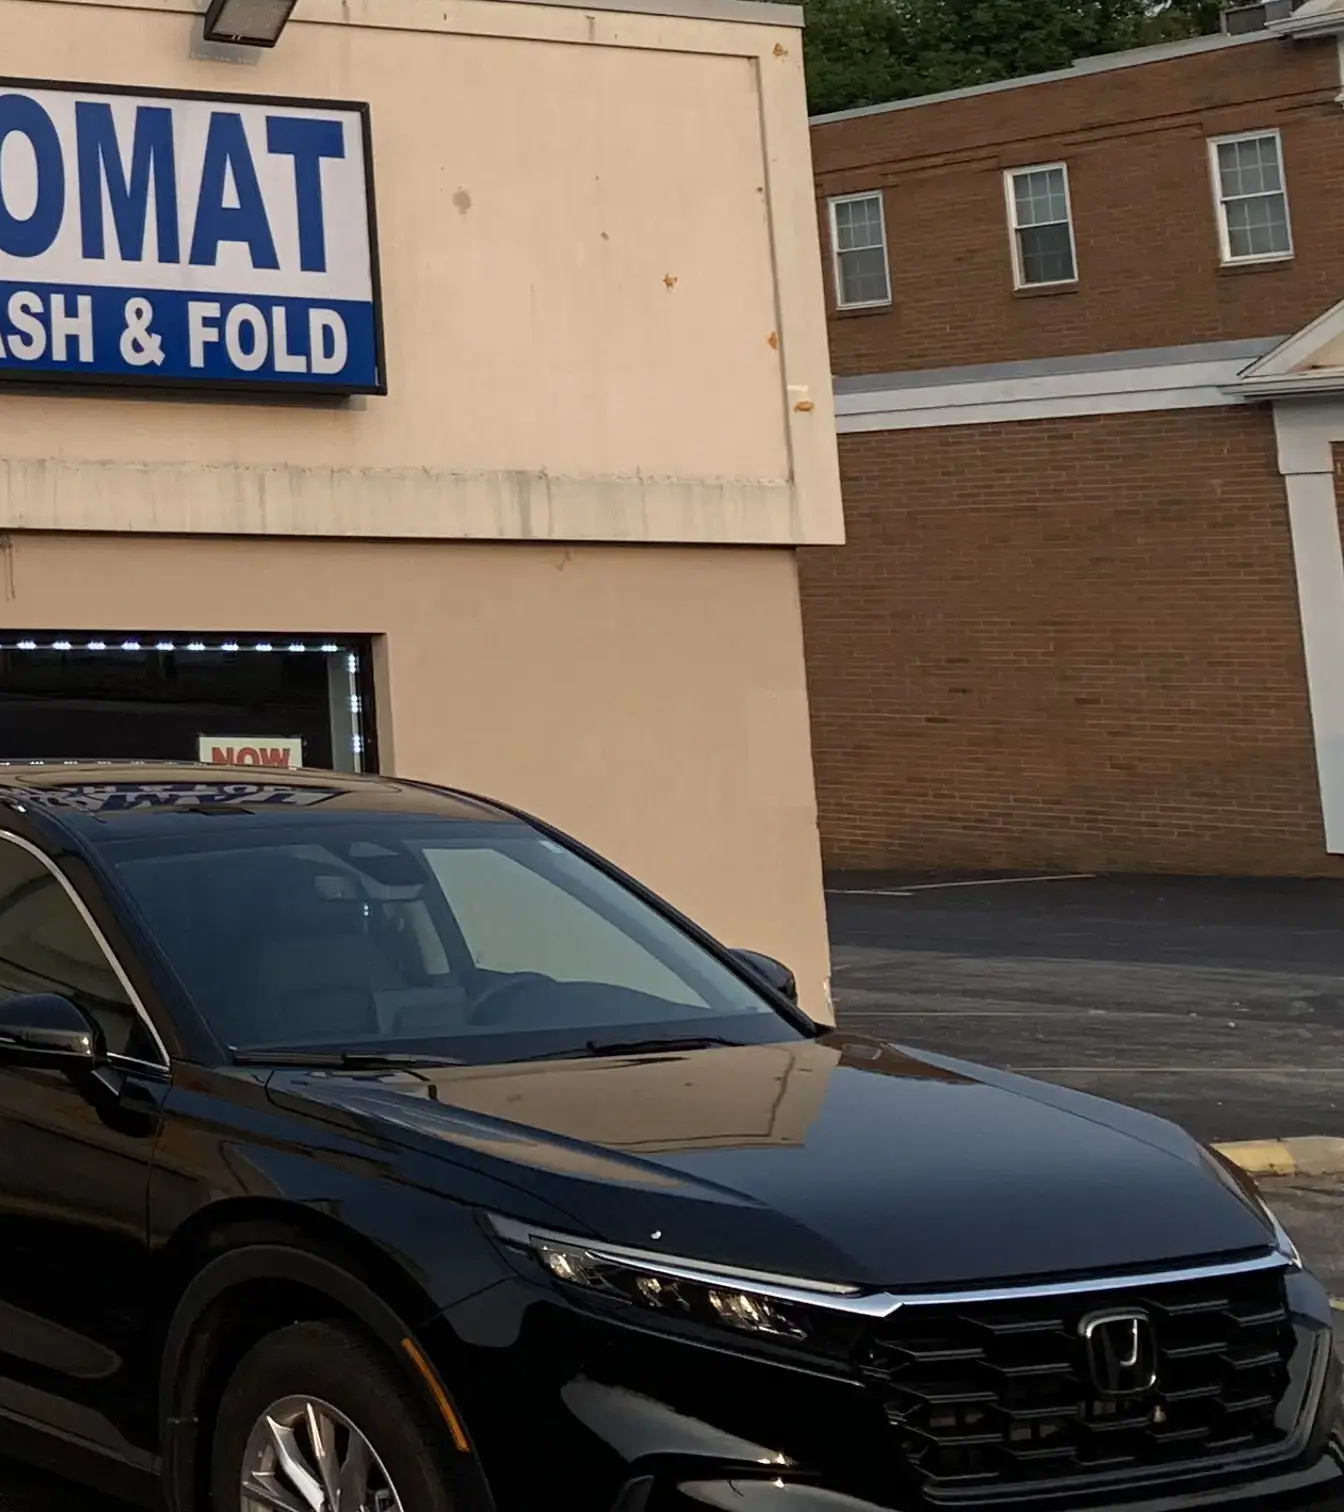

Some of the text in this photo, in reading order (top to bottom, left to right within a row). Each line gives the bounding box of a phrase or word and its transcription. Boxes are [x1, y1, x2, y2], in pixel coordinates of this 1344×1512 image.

[118, 296, 166, 368] &
[187, 300, 349, 376] FOLD
[211, 746, 291, 766] NOW
